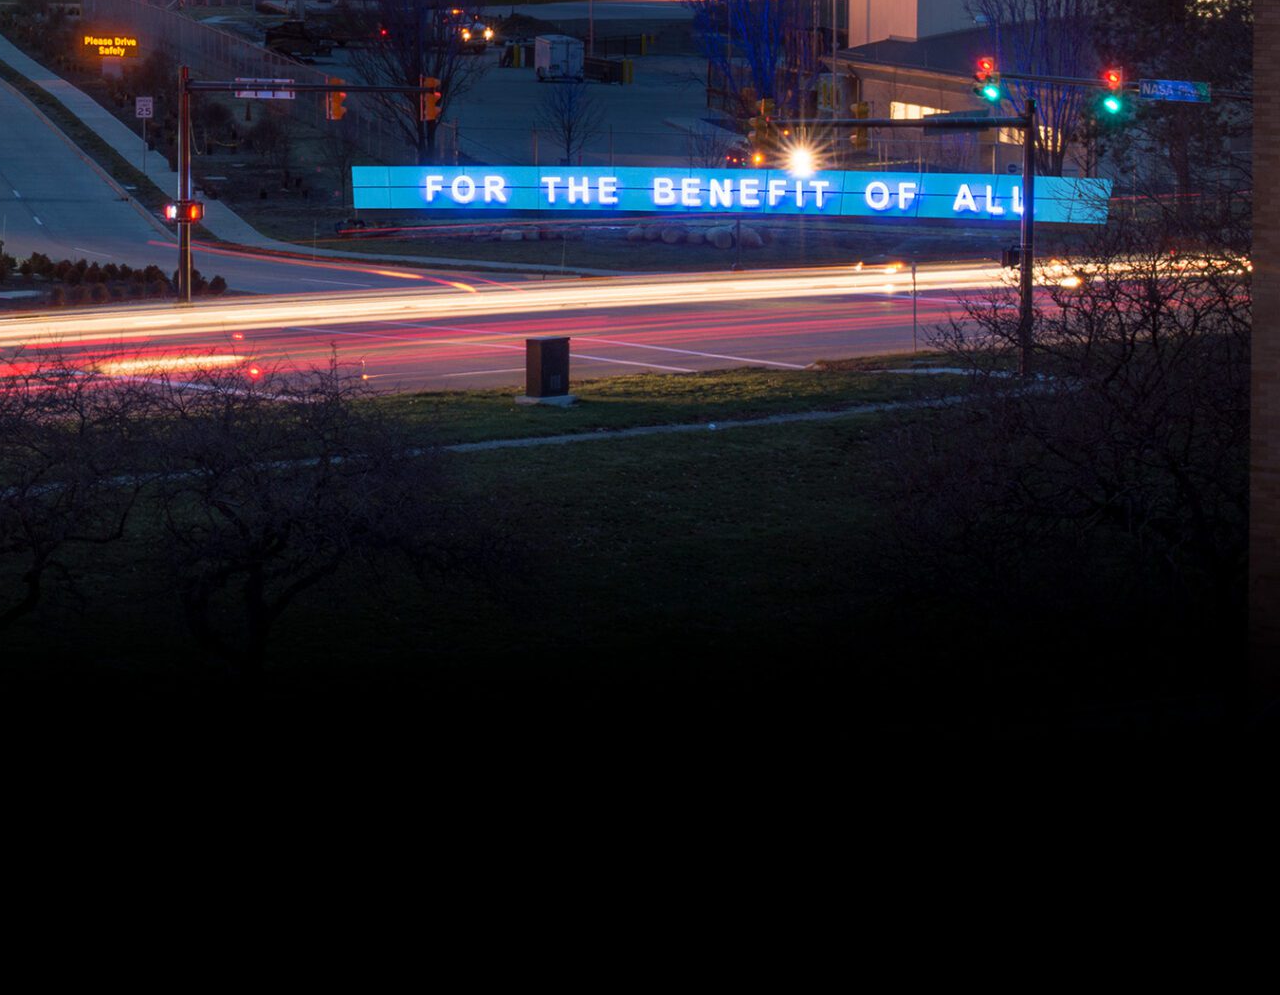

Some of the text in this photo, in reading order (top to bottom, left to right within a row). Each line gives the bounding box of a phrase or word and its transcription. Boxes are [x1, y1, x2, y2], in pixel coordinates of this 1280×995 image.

[84, 36, 137, 46] Please Drive
[99, 47, 125, 57] Safely
[137, 108, 151, 116] 25
[426, 175, 508, 204] FOR
[541, 176, 619, 204] THE
[653, 177, 830, 208] BENEFIT
[865, 181, 917, 211] OF
